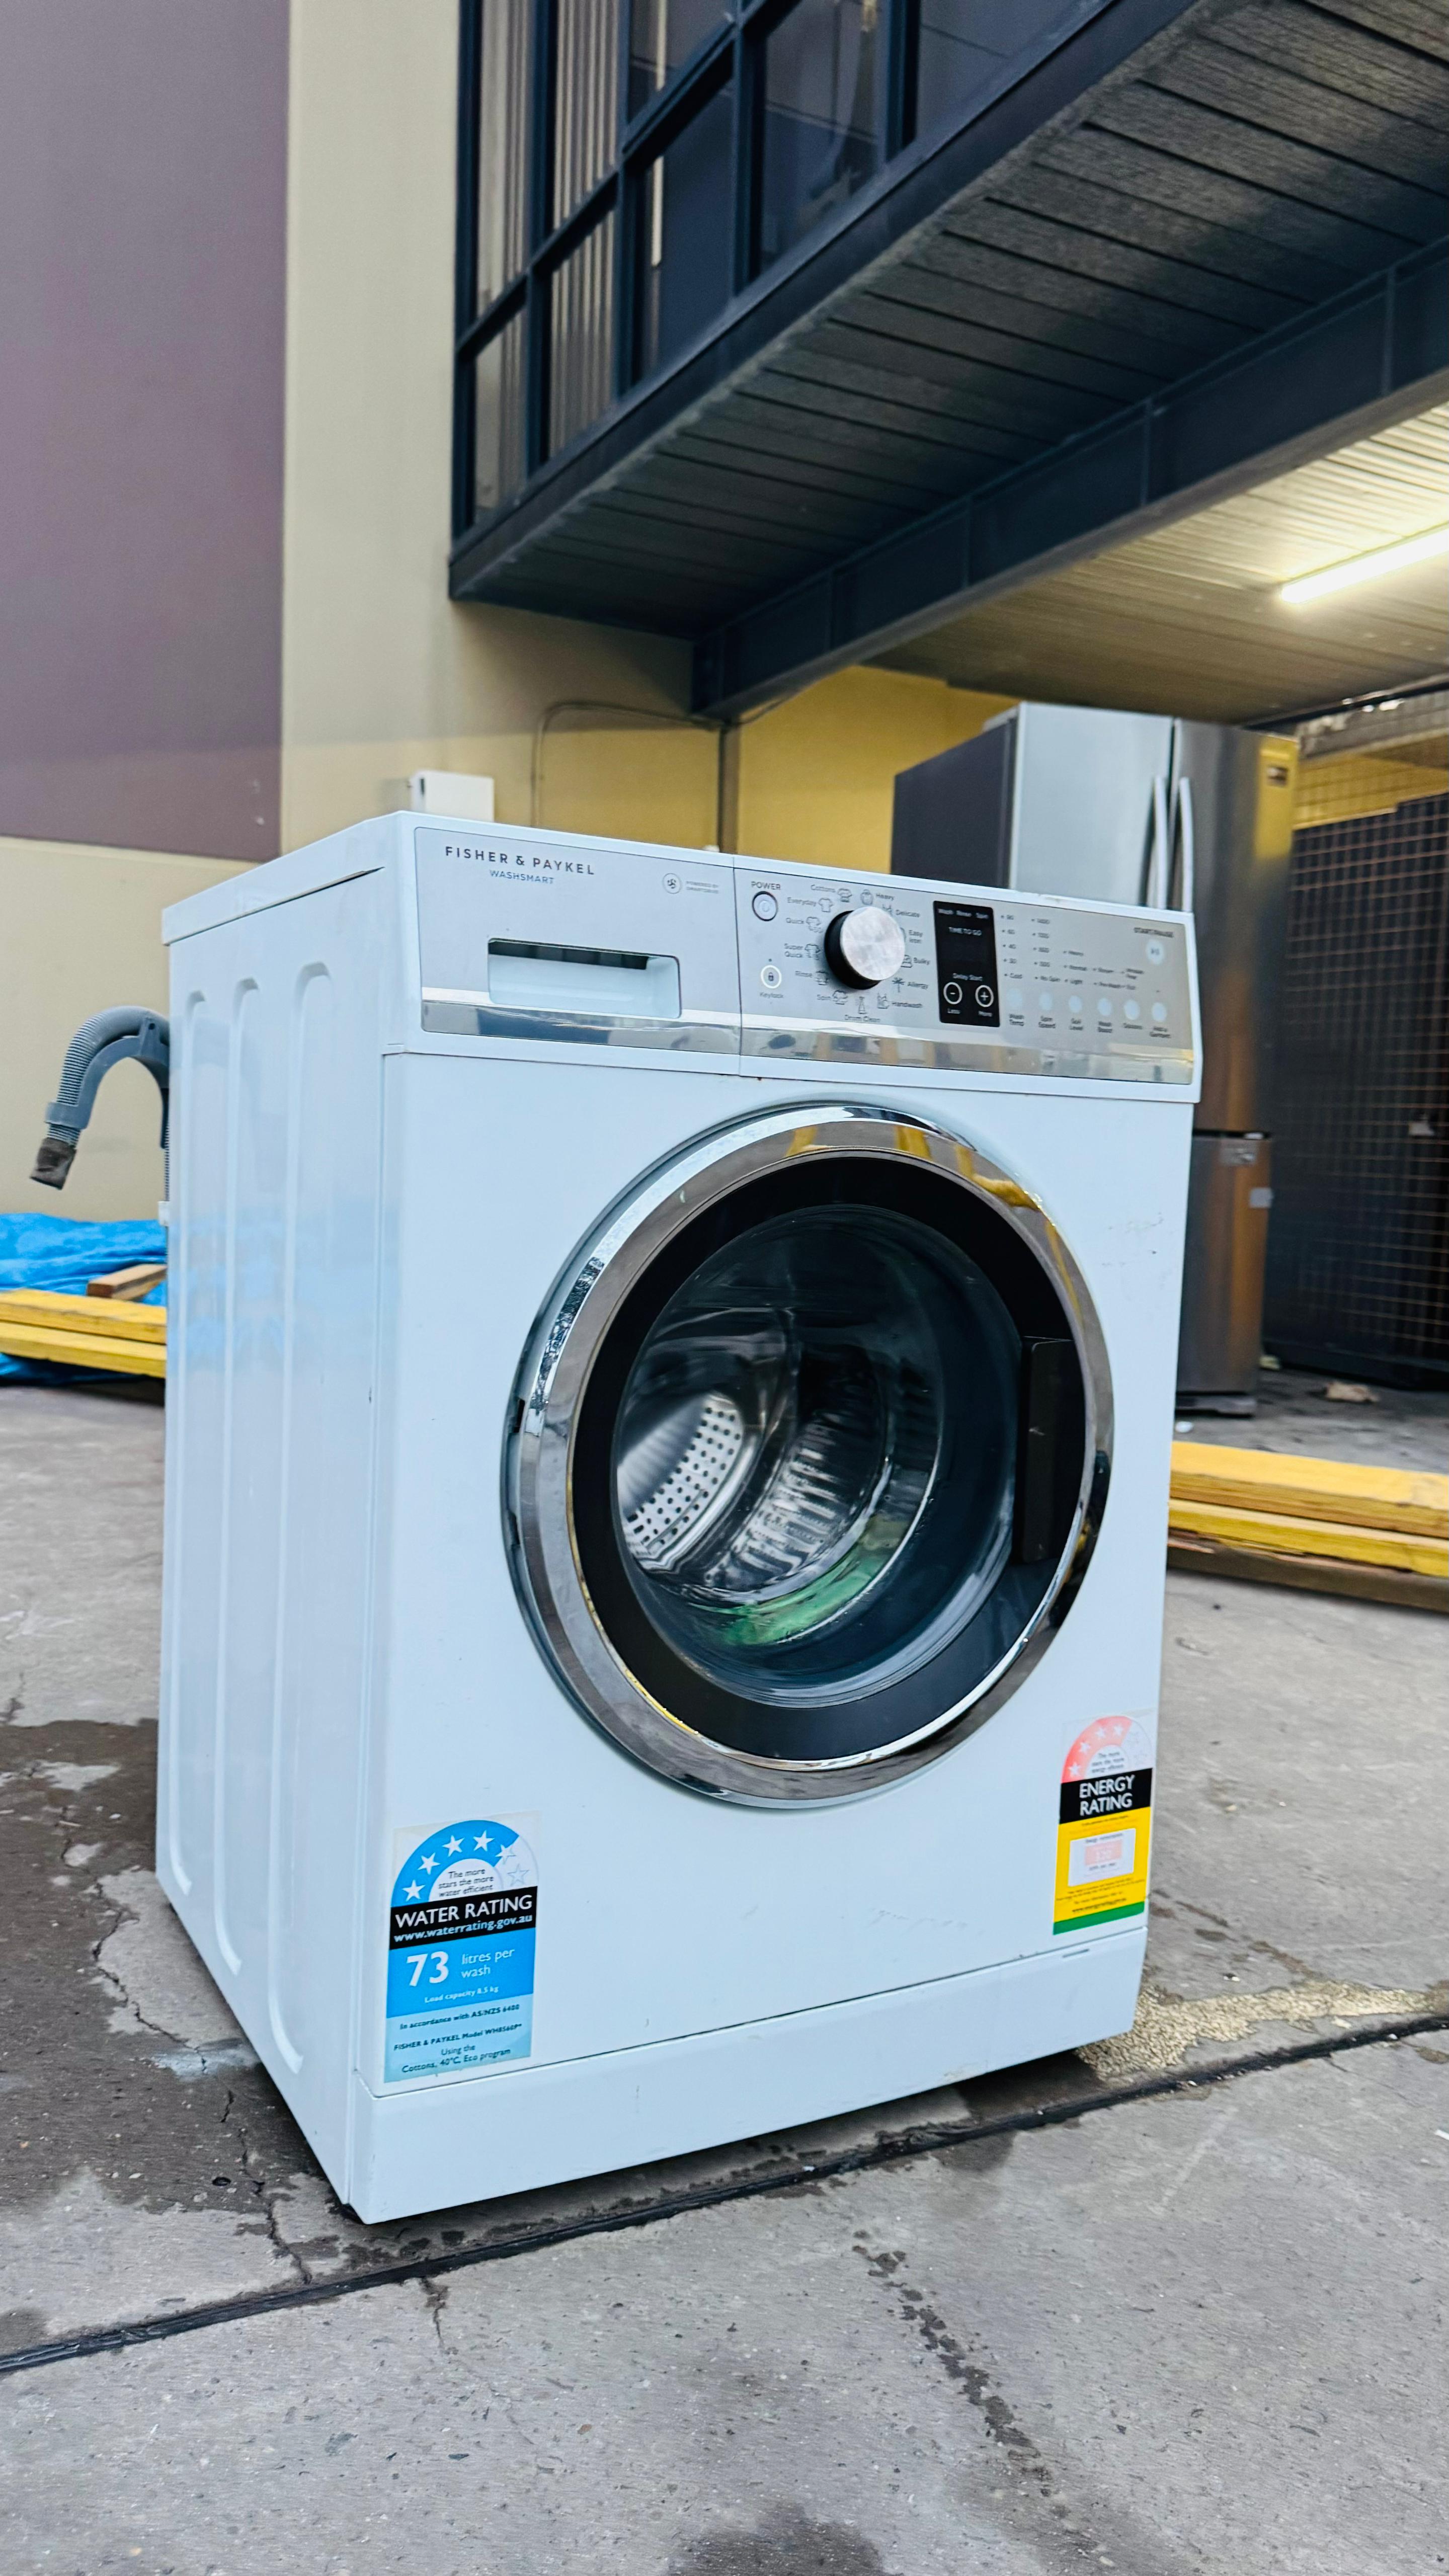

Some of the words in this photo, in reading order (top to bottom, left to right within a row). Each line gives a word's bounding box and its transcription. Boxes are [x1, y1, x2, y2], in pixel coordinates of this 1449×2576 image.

[445, 846, 508, 864] FISHER
[516, 855, 525, 866] &
[533, 857, 594, 875] PAYKEL
[490, 869, 554, 884] WASHSMART
[751, 881, 781, 890] POWER
[787, 897, 817, 907] Everyday
[896, 909, 920, 918] Delicate
[913, 957, 930, 965] Bulky
[1079, 1774, 1135, 1799] ENERGY
[1080, 1792, 1133, 1816] RATING
[463, 1885, 493, 1894] efficient
[395, 1906, 460, 1928] WATER
[464, 1894, 532, 1919] RATING
[393, 1914, 533, 1943] www.waterrating.gov.au
[406, 1951, 449, 1987] 73
[461, 1953, 491, 1965] litres
[495, 1949, 515, 1963] per
[461, 1964, 491, 1979] wash
[424, 1994, 443, 2003] Load
[445, 1990, 475, 1999] capacity
[410, 2017, 451, 2028] accordance
[394, 2041, 421, 2051] FISHER
[431, 2034, 460, 2044] PAYKEL
[462, 2030, 483, 2039] Model
[480, 2049, 511, 2061] program
